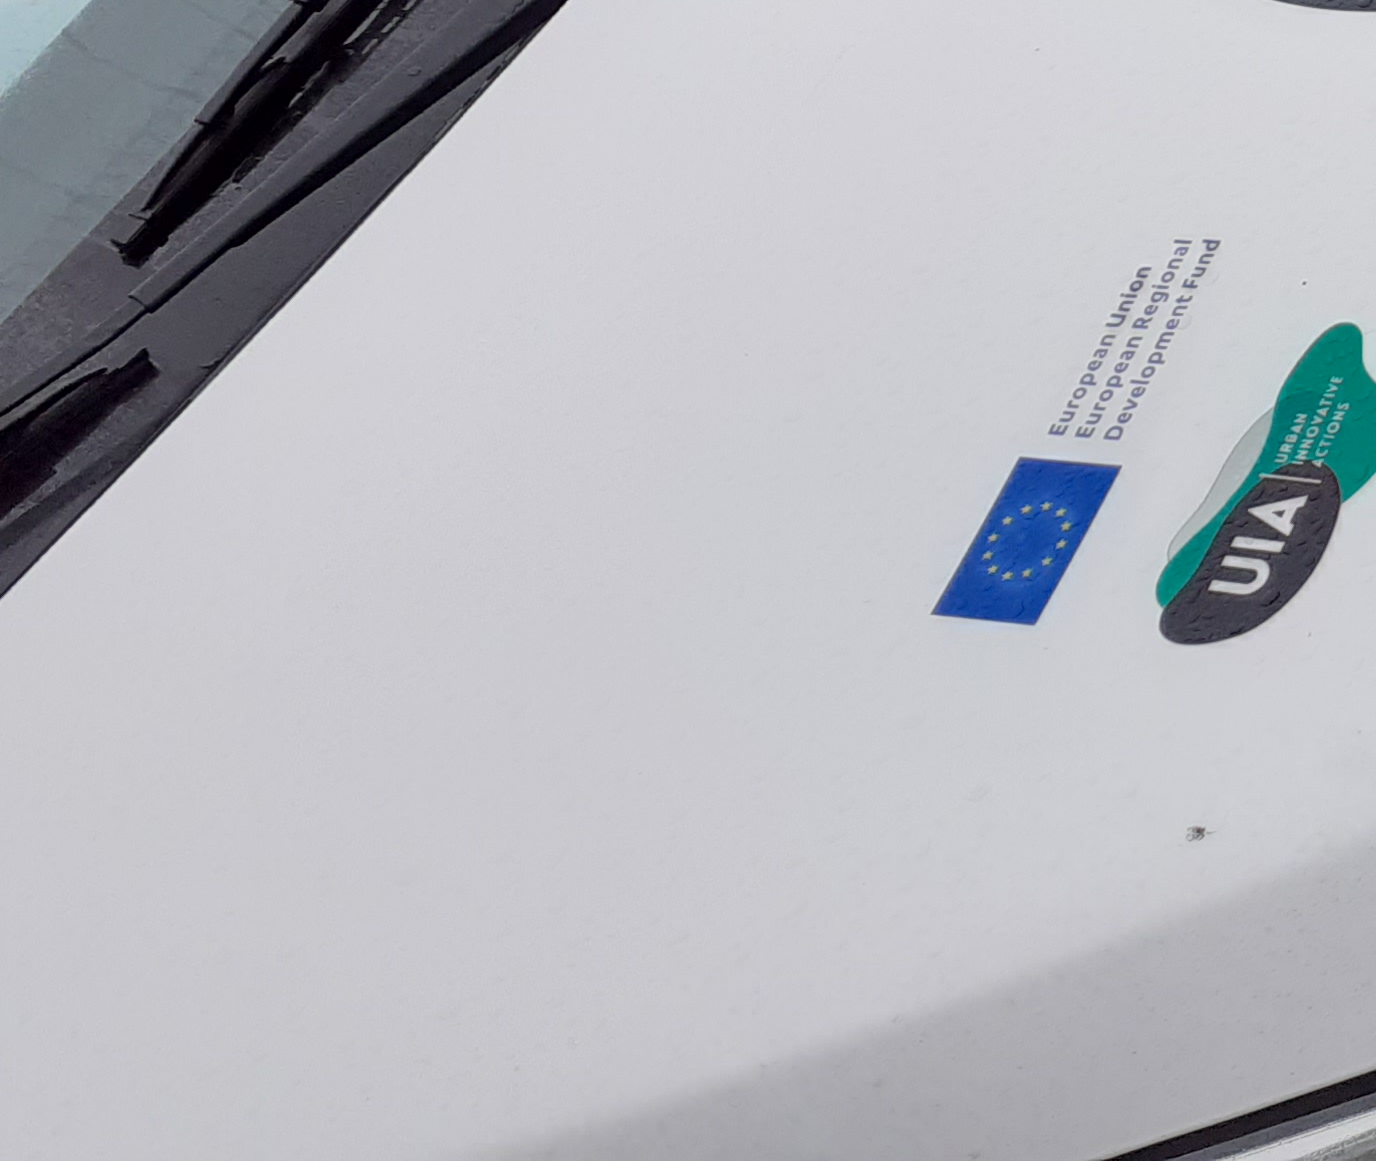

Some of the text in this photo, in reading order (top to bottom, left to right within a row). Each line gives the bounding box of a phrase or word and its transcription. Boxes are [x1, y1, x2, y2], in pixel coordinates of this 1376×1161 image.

[1048, 265, 1153, 437] European Union
[1075, 239, 1193, 439] European Regional
[1104, 239, 1221, 441] Development Fund
[1274, 413, 1308, 464] URBAN
[1294, 375, 1344, 466] INNOVATIVE
[1314, 401, 1350, 468] ACTIONS
[1208, 494, 1309, 597] UIA
